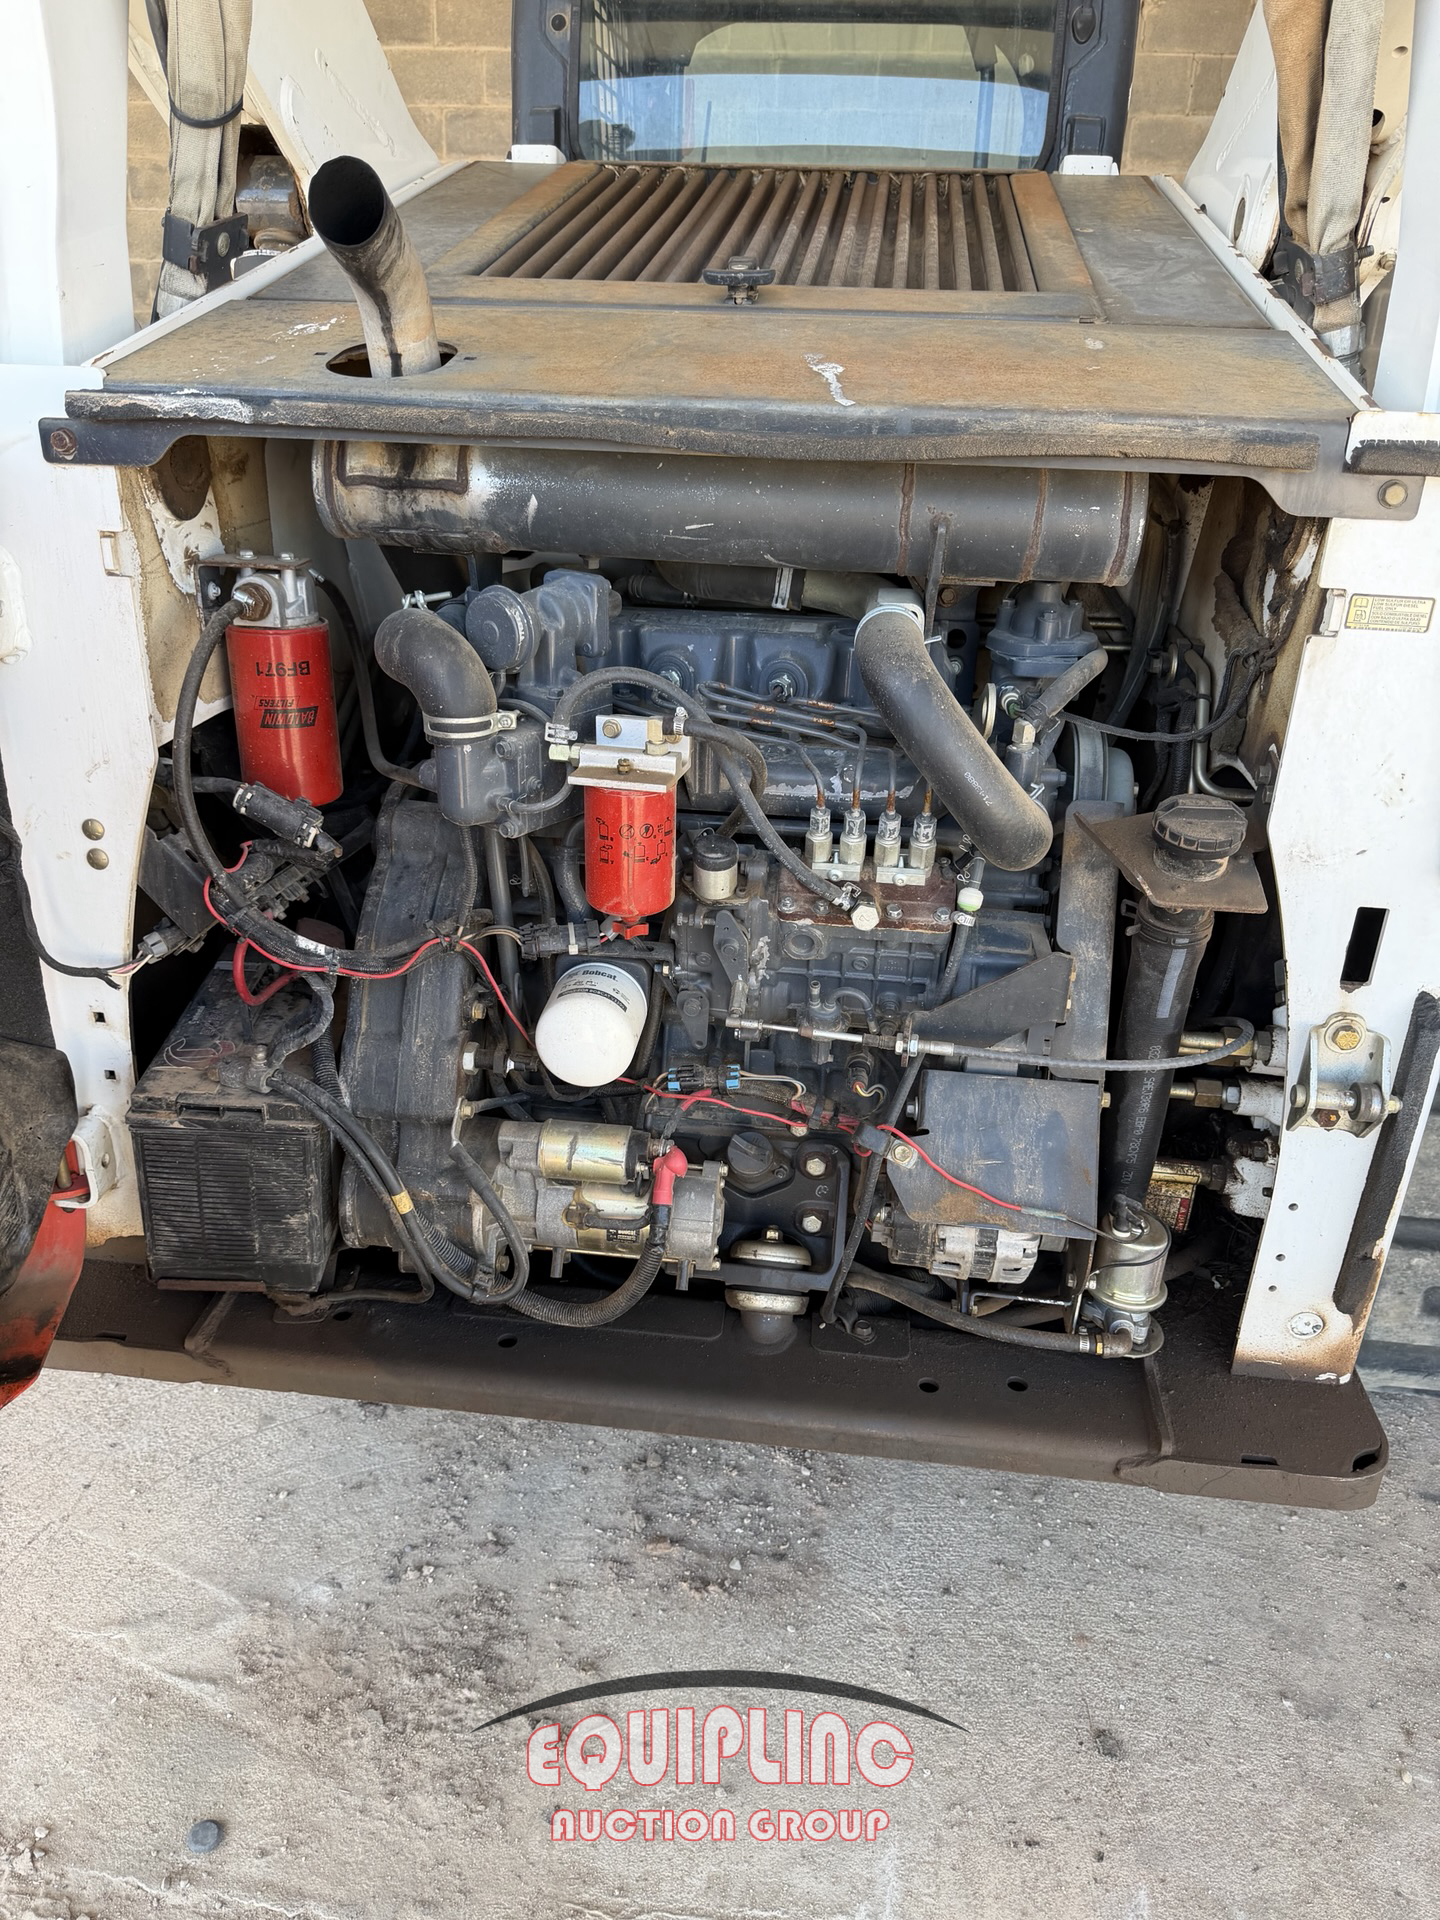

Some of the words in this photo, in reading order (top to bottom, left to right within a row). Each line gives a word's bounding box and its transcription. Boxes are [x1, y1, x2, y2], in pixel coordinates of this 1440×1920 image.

[256, 660, 310, 676] BF971
[258, 698, 295, 708] FILTERS
[264, 710, 315, 725] BALDWIN
[582, 970, 617, 981] Bobcat
